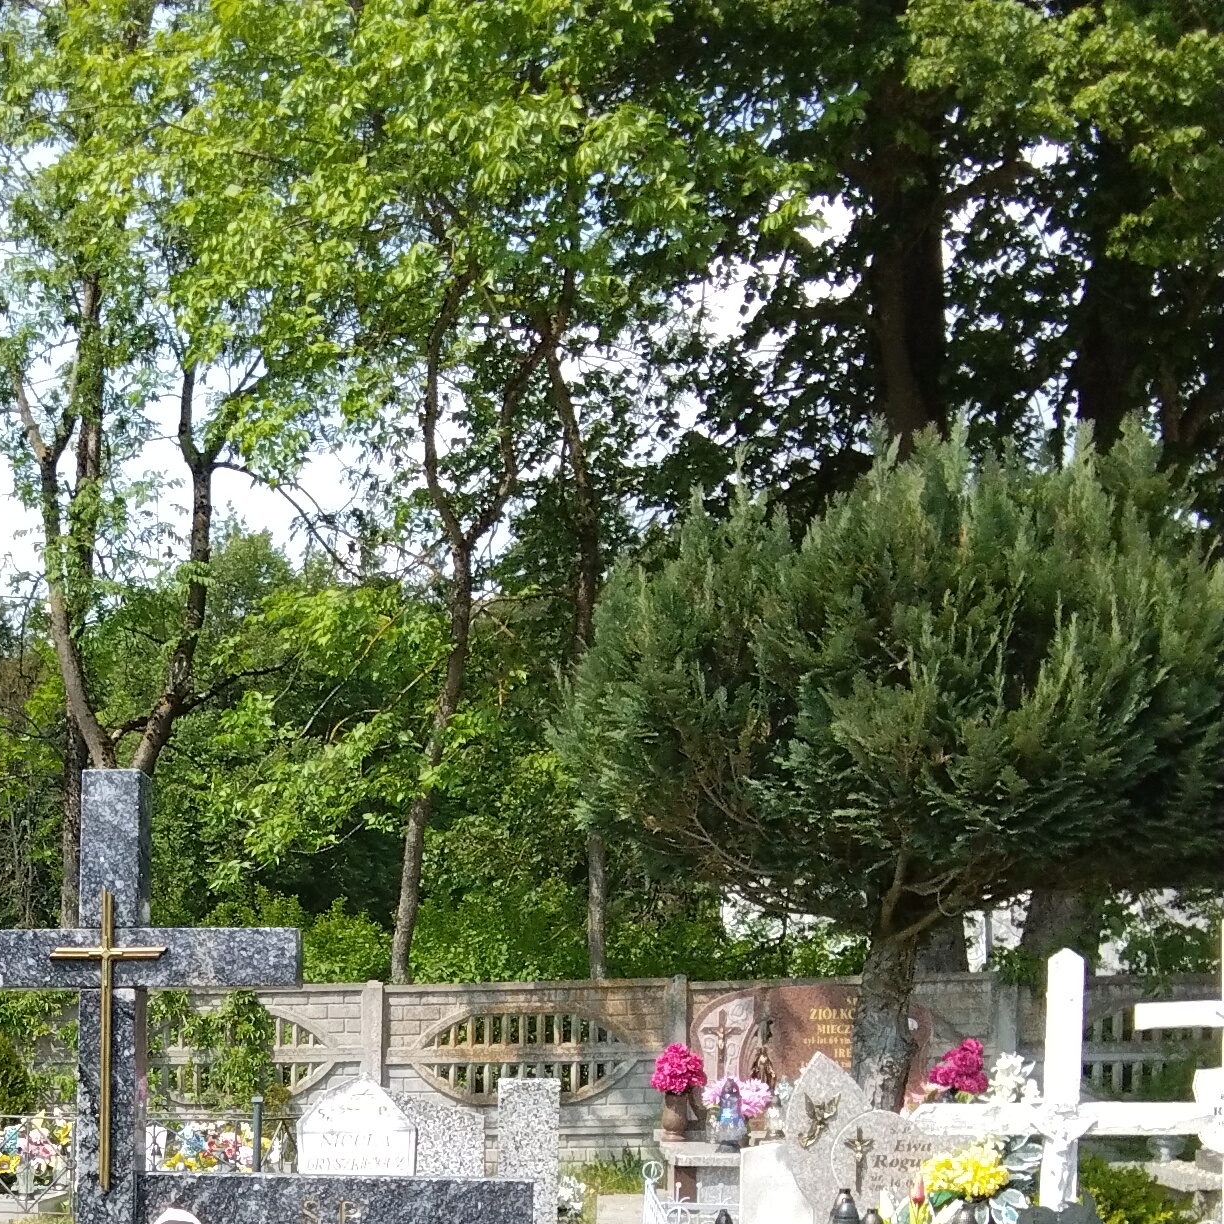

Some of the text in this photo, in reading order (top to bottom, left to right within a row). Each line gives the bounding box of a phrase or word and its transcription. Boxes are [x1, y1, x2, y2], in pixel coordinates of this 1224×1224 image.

[817, 1023, 854, 1034] MIECZ
[834, 1048, 853, 1058] IRE
[894, 1139, 932, 1152] Ewa
